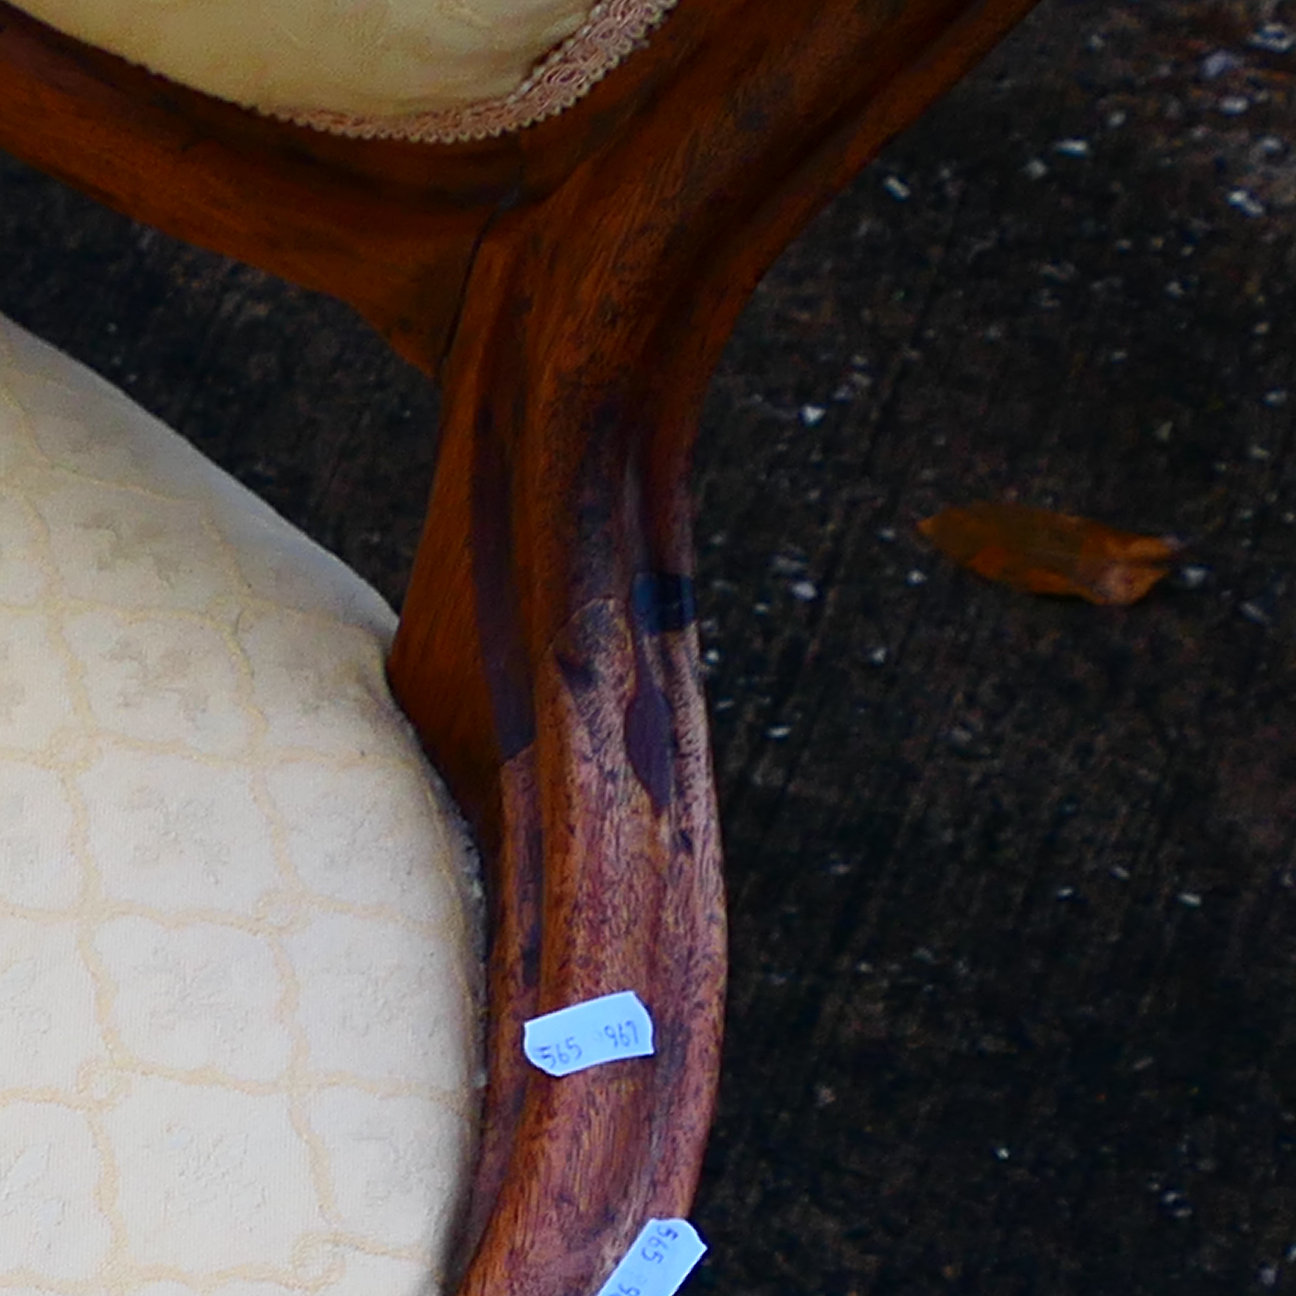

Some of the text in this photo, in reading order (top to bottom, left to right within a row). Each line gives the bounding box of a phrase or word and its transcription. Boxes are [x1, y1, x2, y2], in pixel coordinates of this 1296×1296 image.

[538, 1020, 640, 1068] 565 967
[641, 1225, 679, 1264] 565
